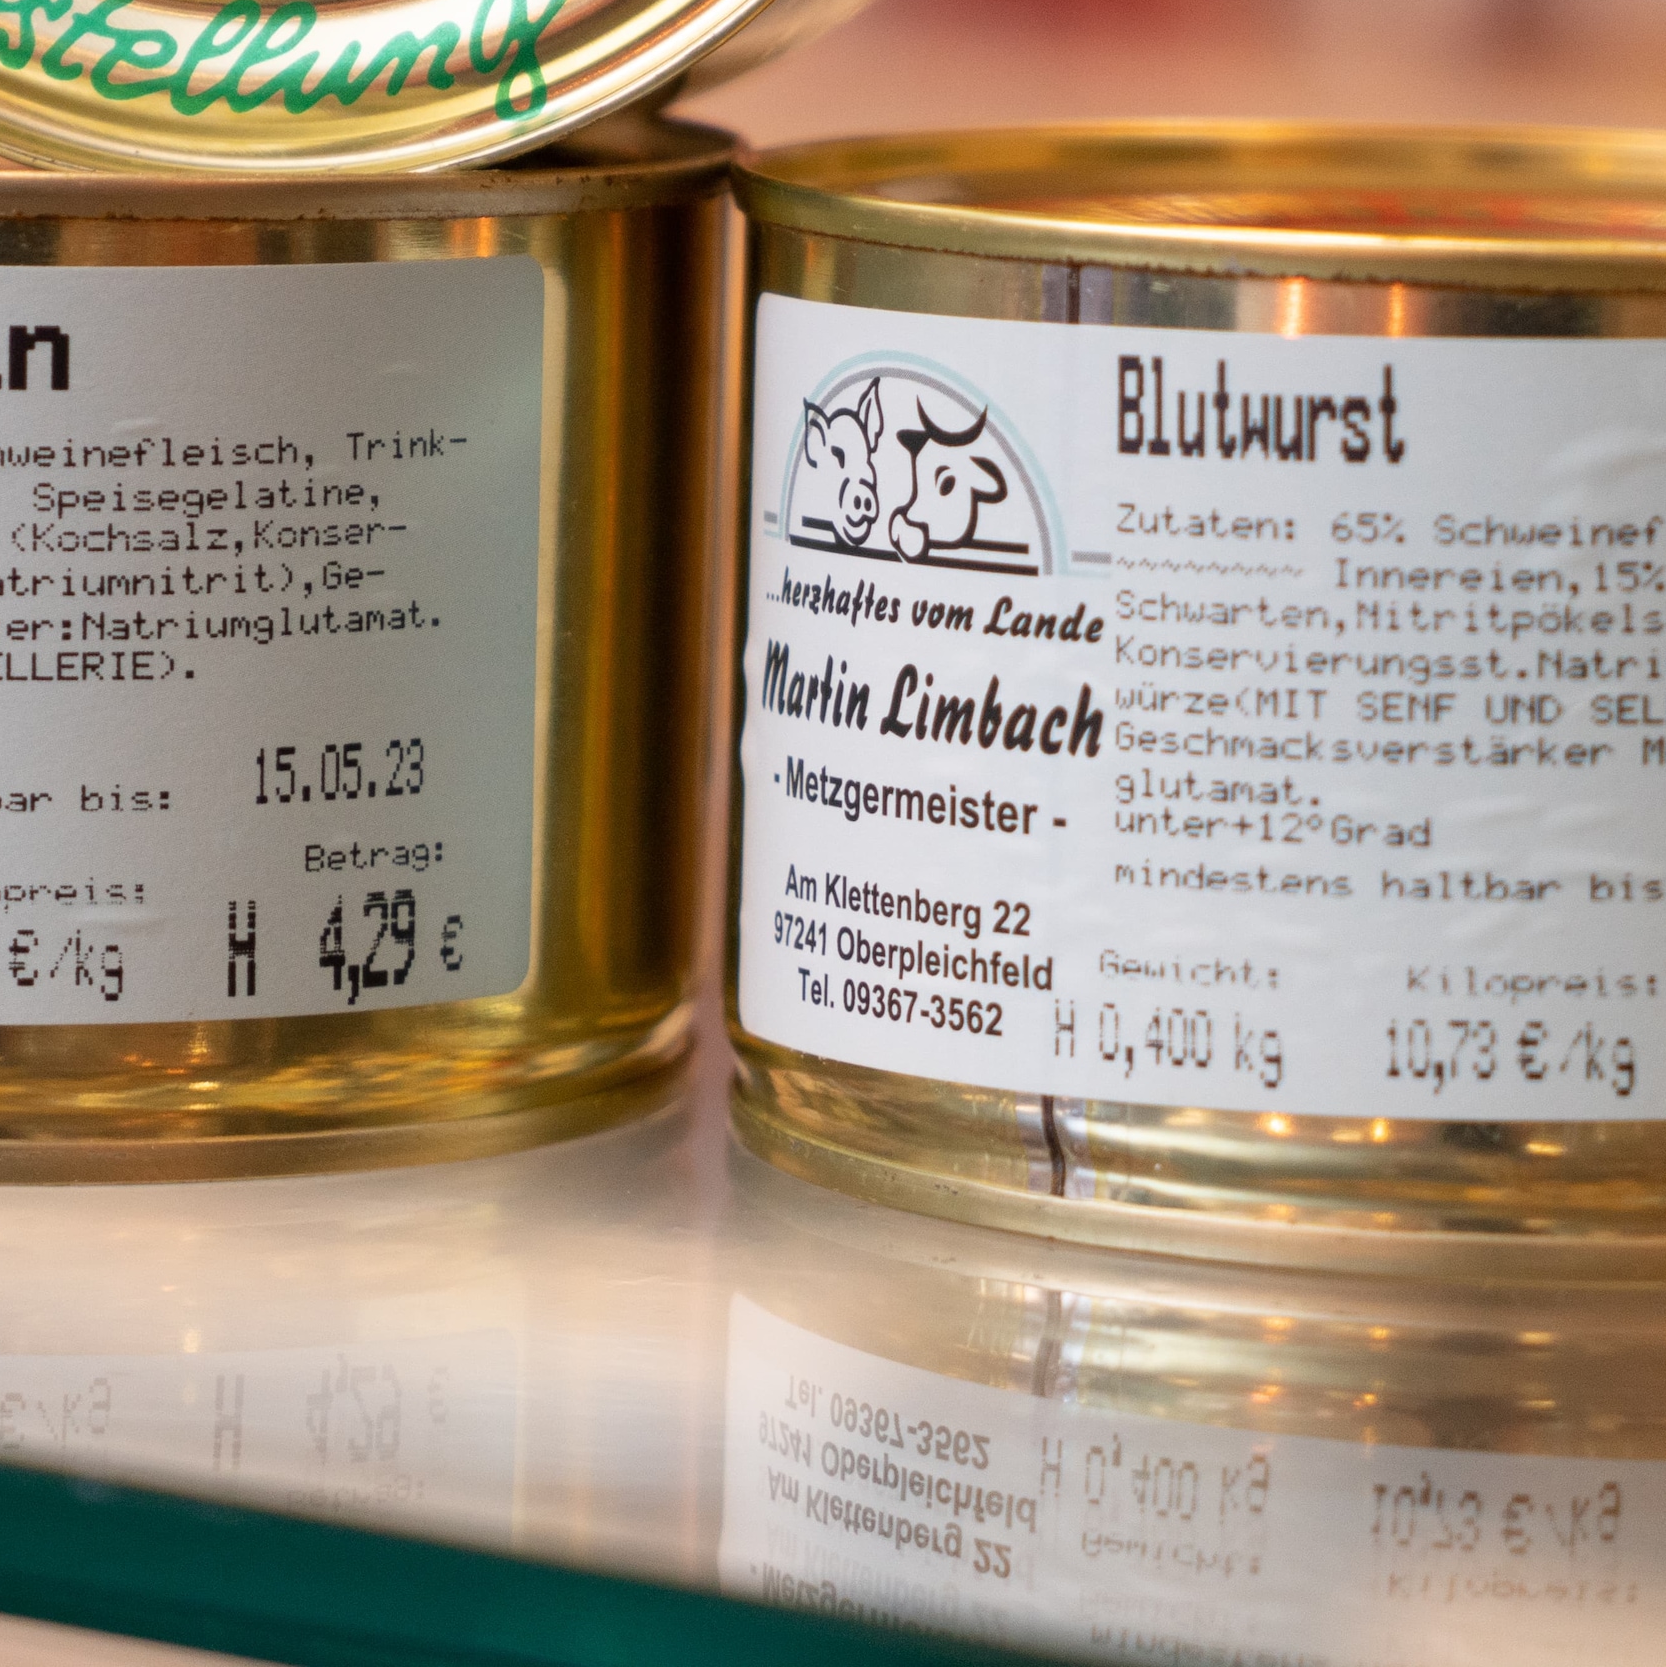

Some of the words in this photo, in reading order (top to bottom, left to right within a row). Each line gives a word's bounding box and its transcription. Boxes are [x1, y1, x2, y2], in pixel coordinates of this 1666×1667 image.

[1117, 354, 1406, 464] Blutwurst
[346, 429, 467, 461] Trink-
[32, 479, 379, 518] Speisegelatine,
[1116, 503, 1297, 541] Zutaten:
[1331, 512, 1406, 545] 65%
[911, 596, 973, 632] vom
[983, 594, 1104, 644] Lande
[762, 637, 870, 731] Martin
[880, 663, 1104, 757] Limbach
[1356, 689, 1456, 723] SENF
[1485, 693, 1563, 725] UND
[81, 784, 169, 812] bis:
[256, 737, 424, 804] 15.05.23
[1115, 722, 1613, 767] Geschmacksverstärker
[786, 755, 1038, 835] Metzgermeister
[1115, 768, 1320, 806] glutamat.
[305, 841, 443, 872] Betrag:
[1115, 858, 1353, 896] mindestens
[1382, 870, 1561, 901] haltbar
[785, 863, 818, 903] Am
[825, 872, 982, 939] Klettenberg
[992, 899, 1031, 936] 22
[8, 929, 123, 1001] €/kg
[228, 900, 256, 997] H
[319, 888, 416, 1005] 4,29
[440, 914, 463, 972] €
[774, 911, 827, 957] 97241
[836, 926, 1053, 991] Oberpleichfeld
[1099, 948, 1280, 991] Gewicht:
[798, 967, 835, 1009] Tel.
[843, 977, 1003, 1037] 09367-3562
[1407, 965, 1658, 1005] Kilopreis:
[1054, 999, 1075, 1058] H
[1099, 1002, 1212, 1079] 0,400
[1235, 1012, 1283, 1088] kg
[1387, 1018, 1496, 1094] 10,73
[1517, 1019, 1635, 1096] €/kg
